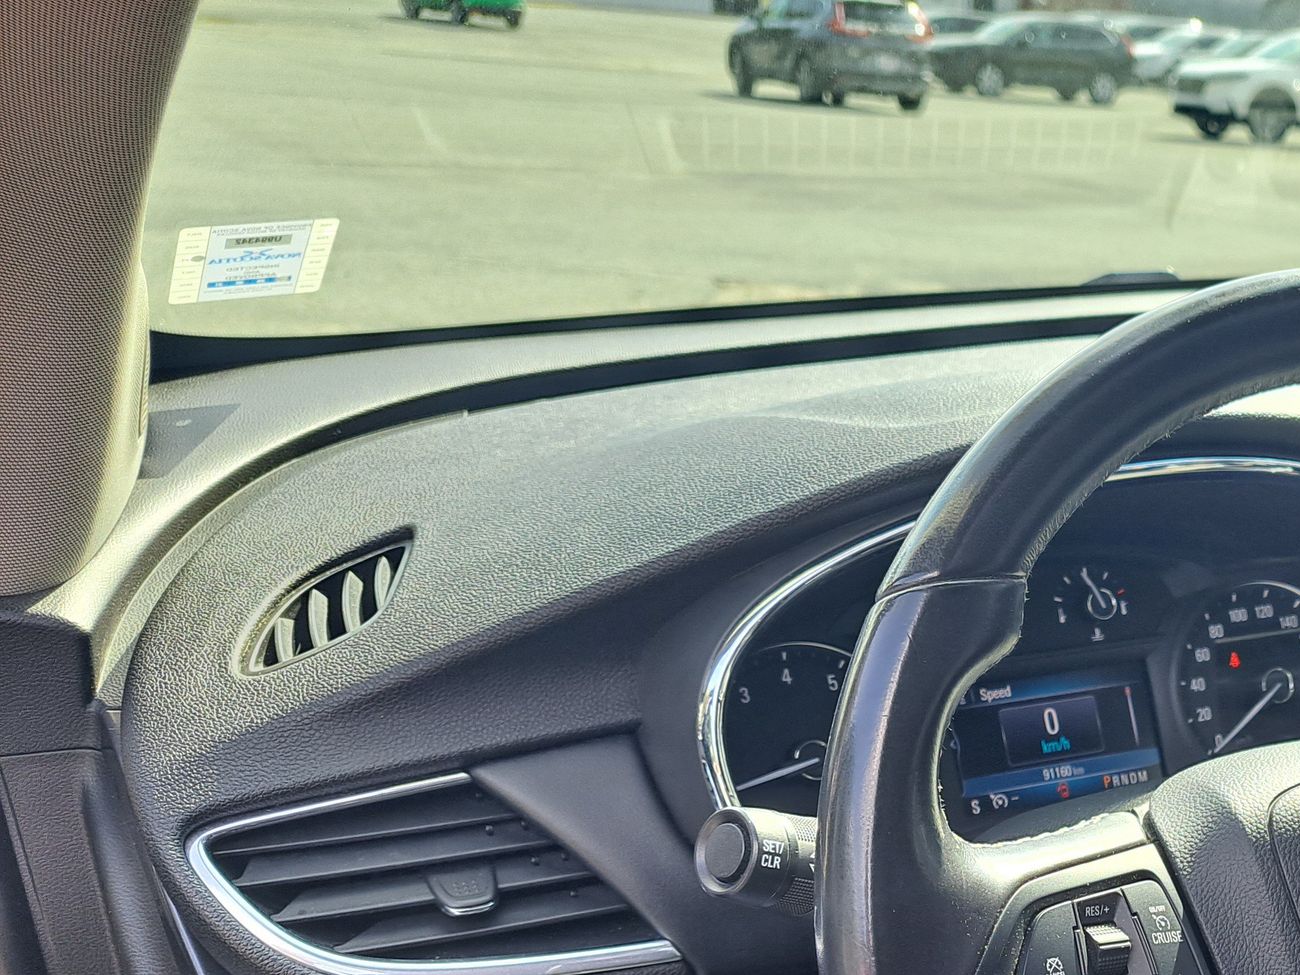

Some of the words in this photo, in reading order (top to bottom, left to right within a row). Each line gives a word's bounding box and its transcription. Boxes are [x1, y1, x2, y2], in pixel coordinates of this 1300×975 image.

[1229, 608, 1248, 623] 100
[1255, 604, 1274, 619] 120
[1279, 615, 1298, 629] 140
[1208, 624, 1224, 639] 80
[1195, 647, 1211, 663] 60
[781, 669, 792, 684] 4
[827, 673, 838, 691] 5
[1190, 677, 1206, 692] 40
[739, 687, 750, 703] 3
[979, 685, 1012, 703] Speed
[1043, 707, 1060, 735] 0
[1196, 706, 1212, 722] 20
[1040, 736, 1070, 754] km/h
[1215, 733, 1223, 748] 0
[971, 800, 981, 815] S
[762, 840, 785, 854] SET/
[761, 854, 781, 869] CLR
[1151, 930, 1184, 945] CRUISE
